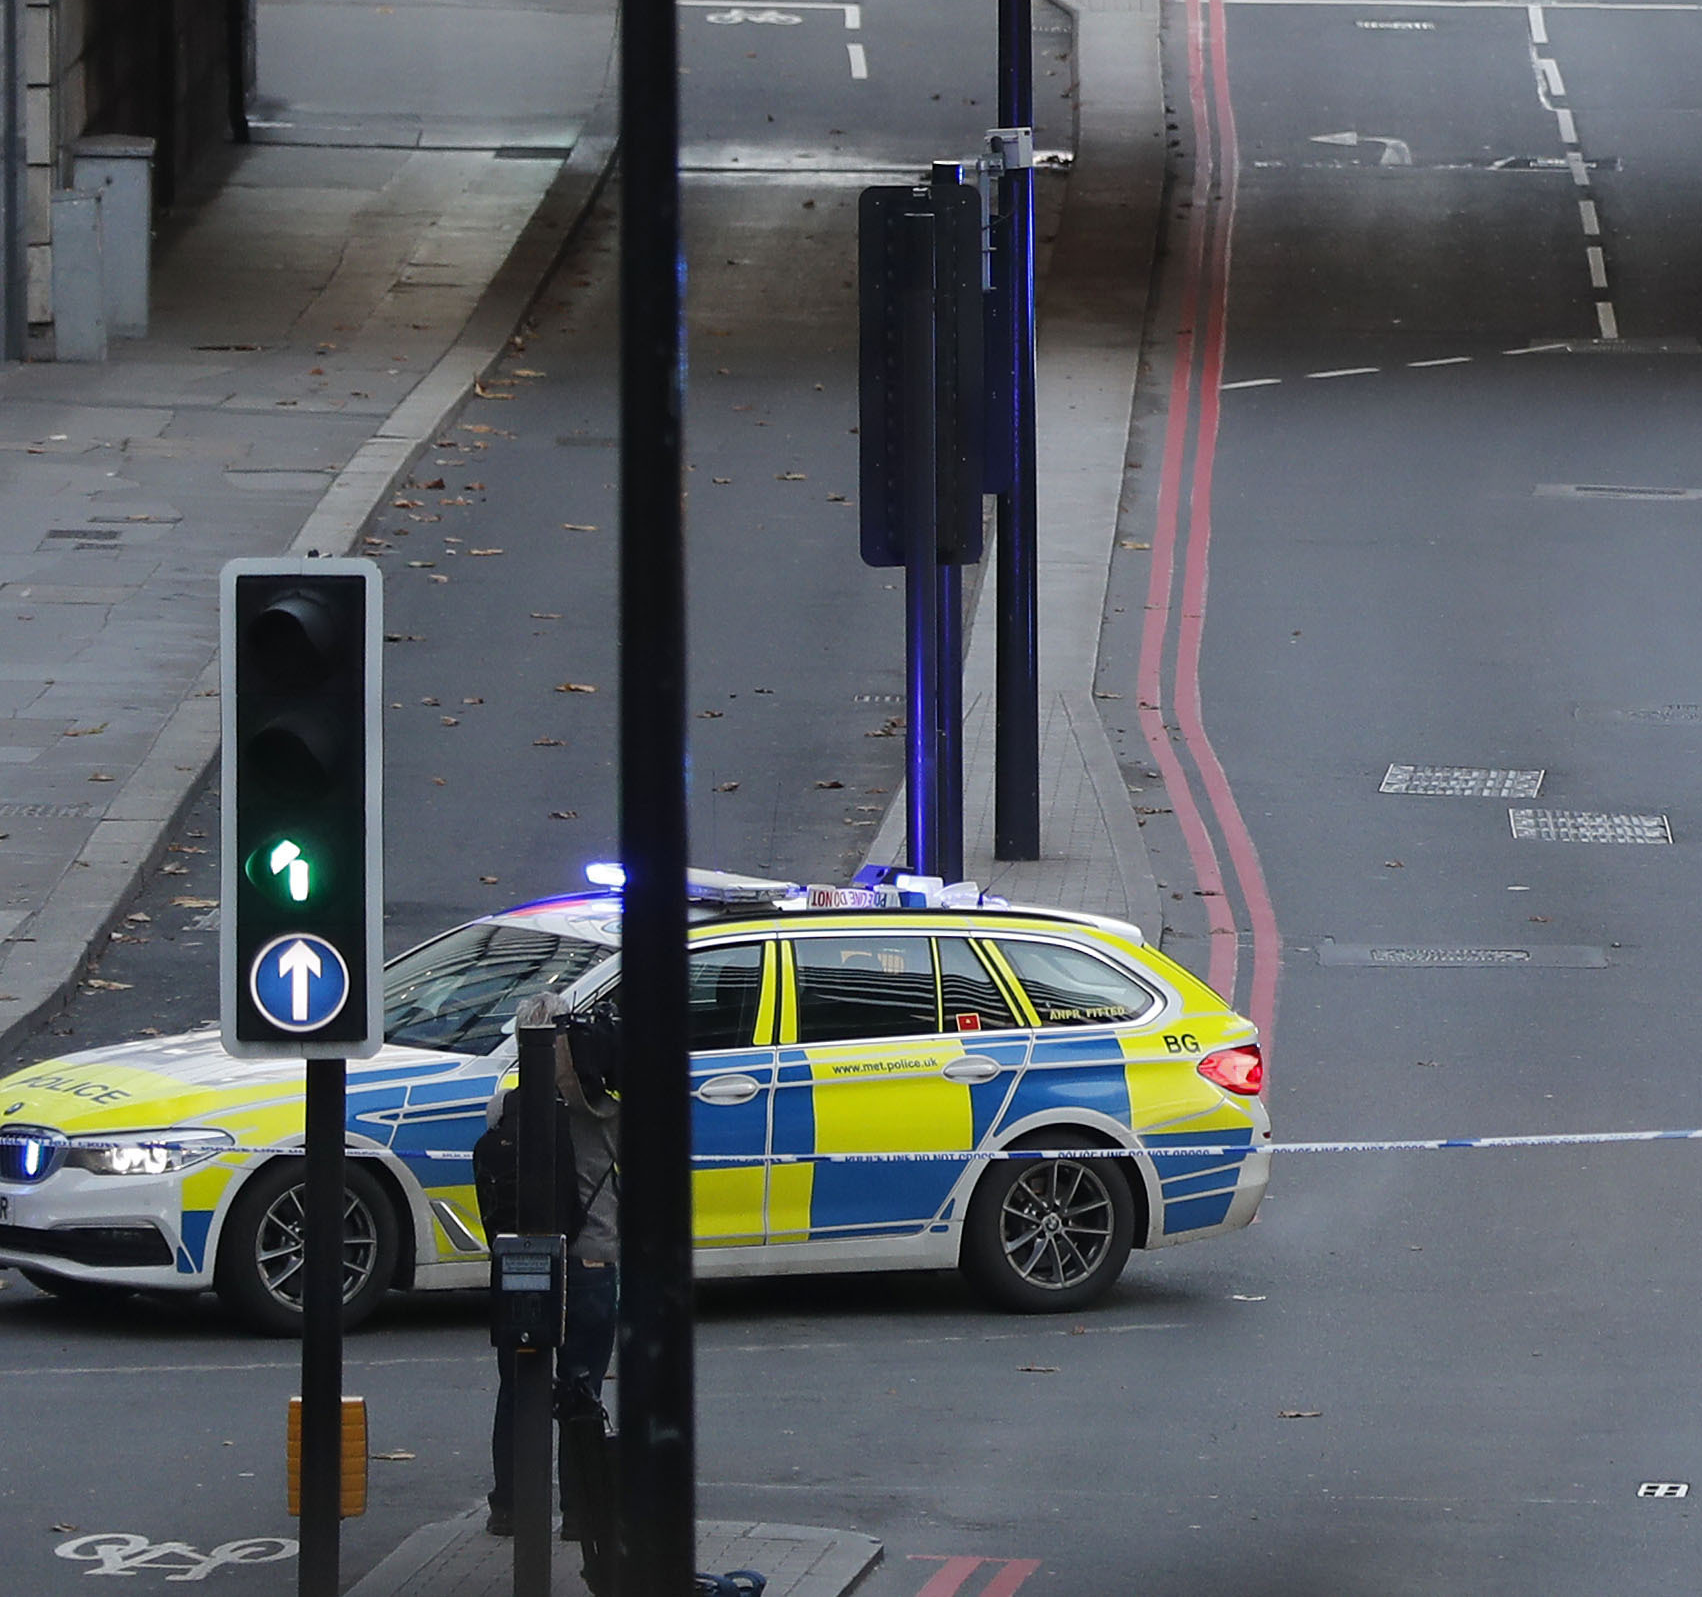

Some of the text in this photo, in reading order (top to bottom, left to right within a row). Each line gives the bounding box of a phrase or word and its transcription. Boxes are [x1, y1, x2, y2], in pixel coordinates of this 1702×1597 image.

[1049, 1006, 1125, 1020] ANPR FITTED
[1164, 1034, 1201, 1054] BG
[832, 1058, 938, 1075] www.met.police.uk
[8, 1075, 132, 1105] POLICE
